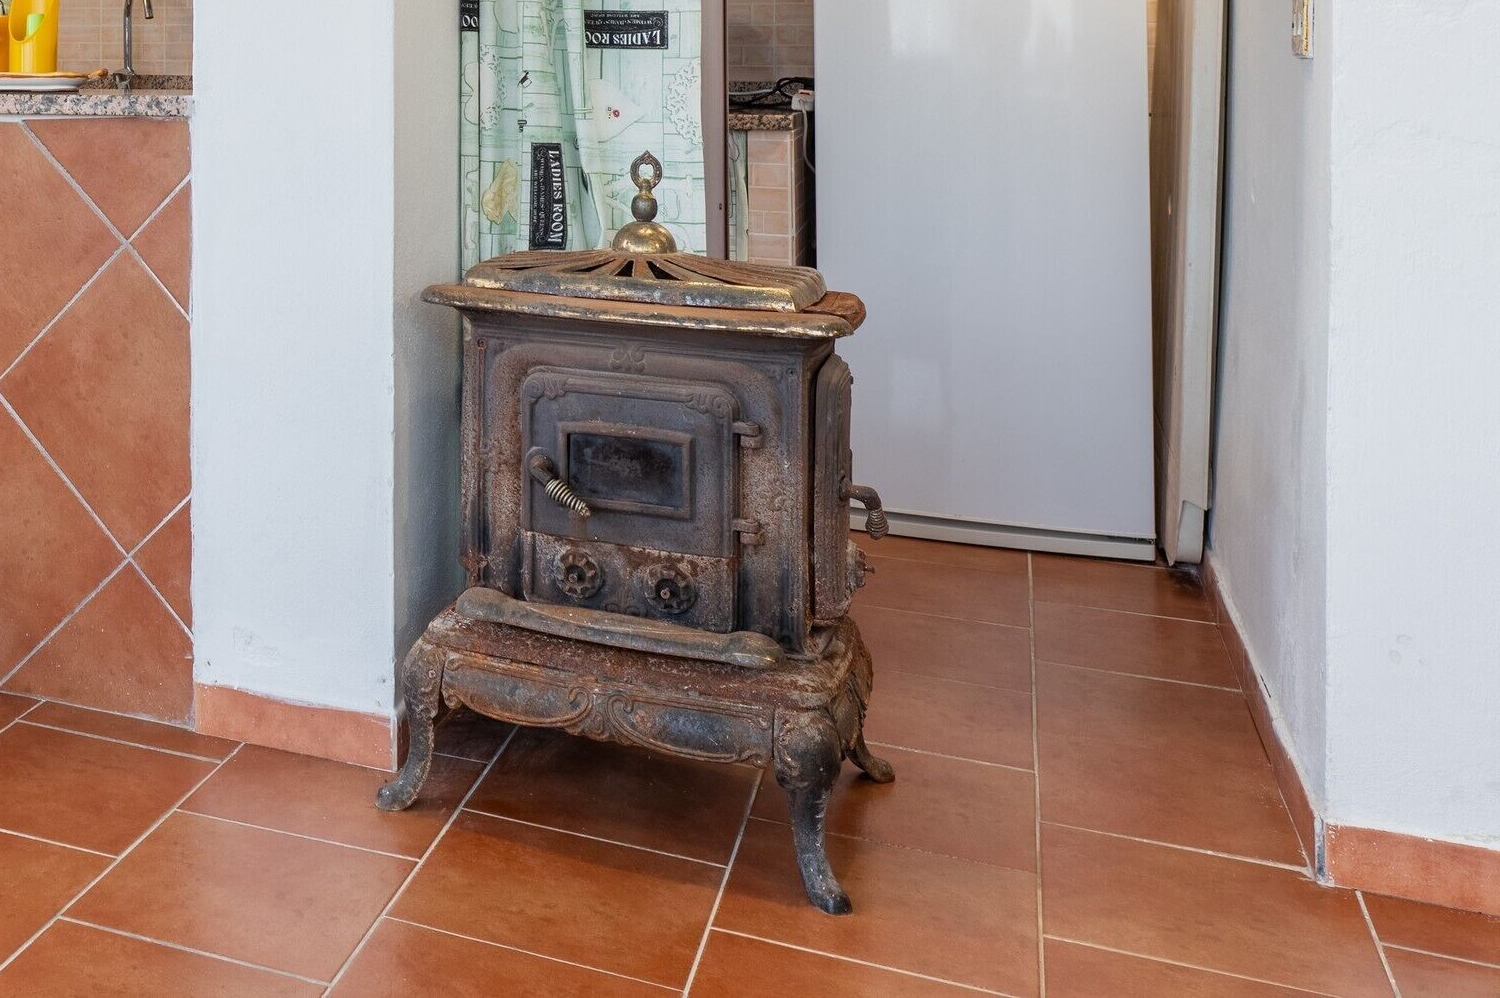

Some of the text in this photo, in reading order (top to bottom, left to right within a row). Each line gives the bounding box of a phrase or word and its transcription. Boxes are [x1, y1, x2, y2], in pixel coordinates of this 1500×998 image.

[585, 29, 661, 45] LADIES ROO
[547, 150, 564, 243] LADIES ROOM
